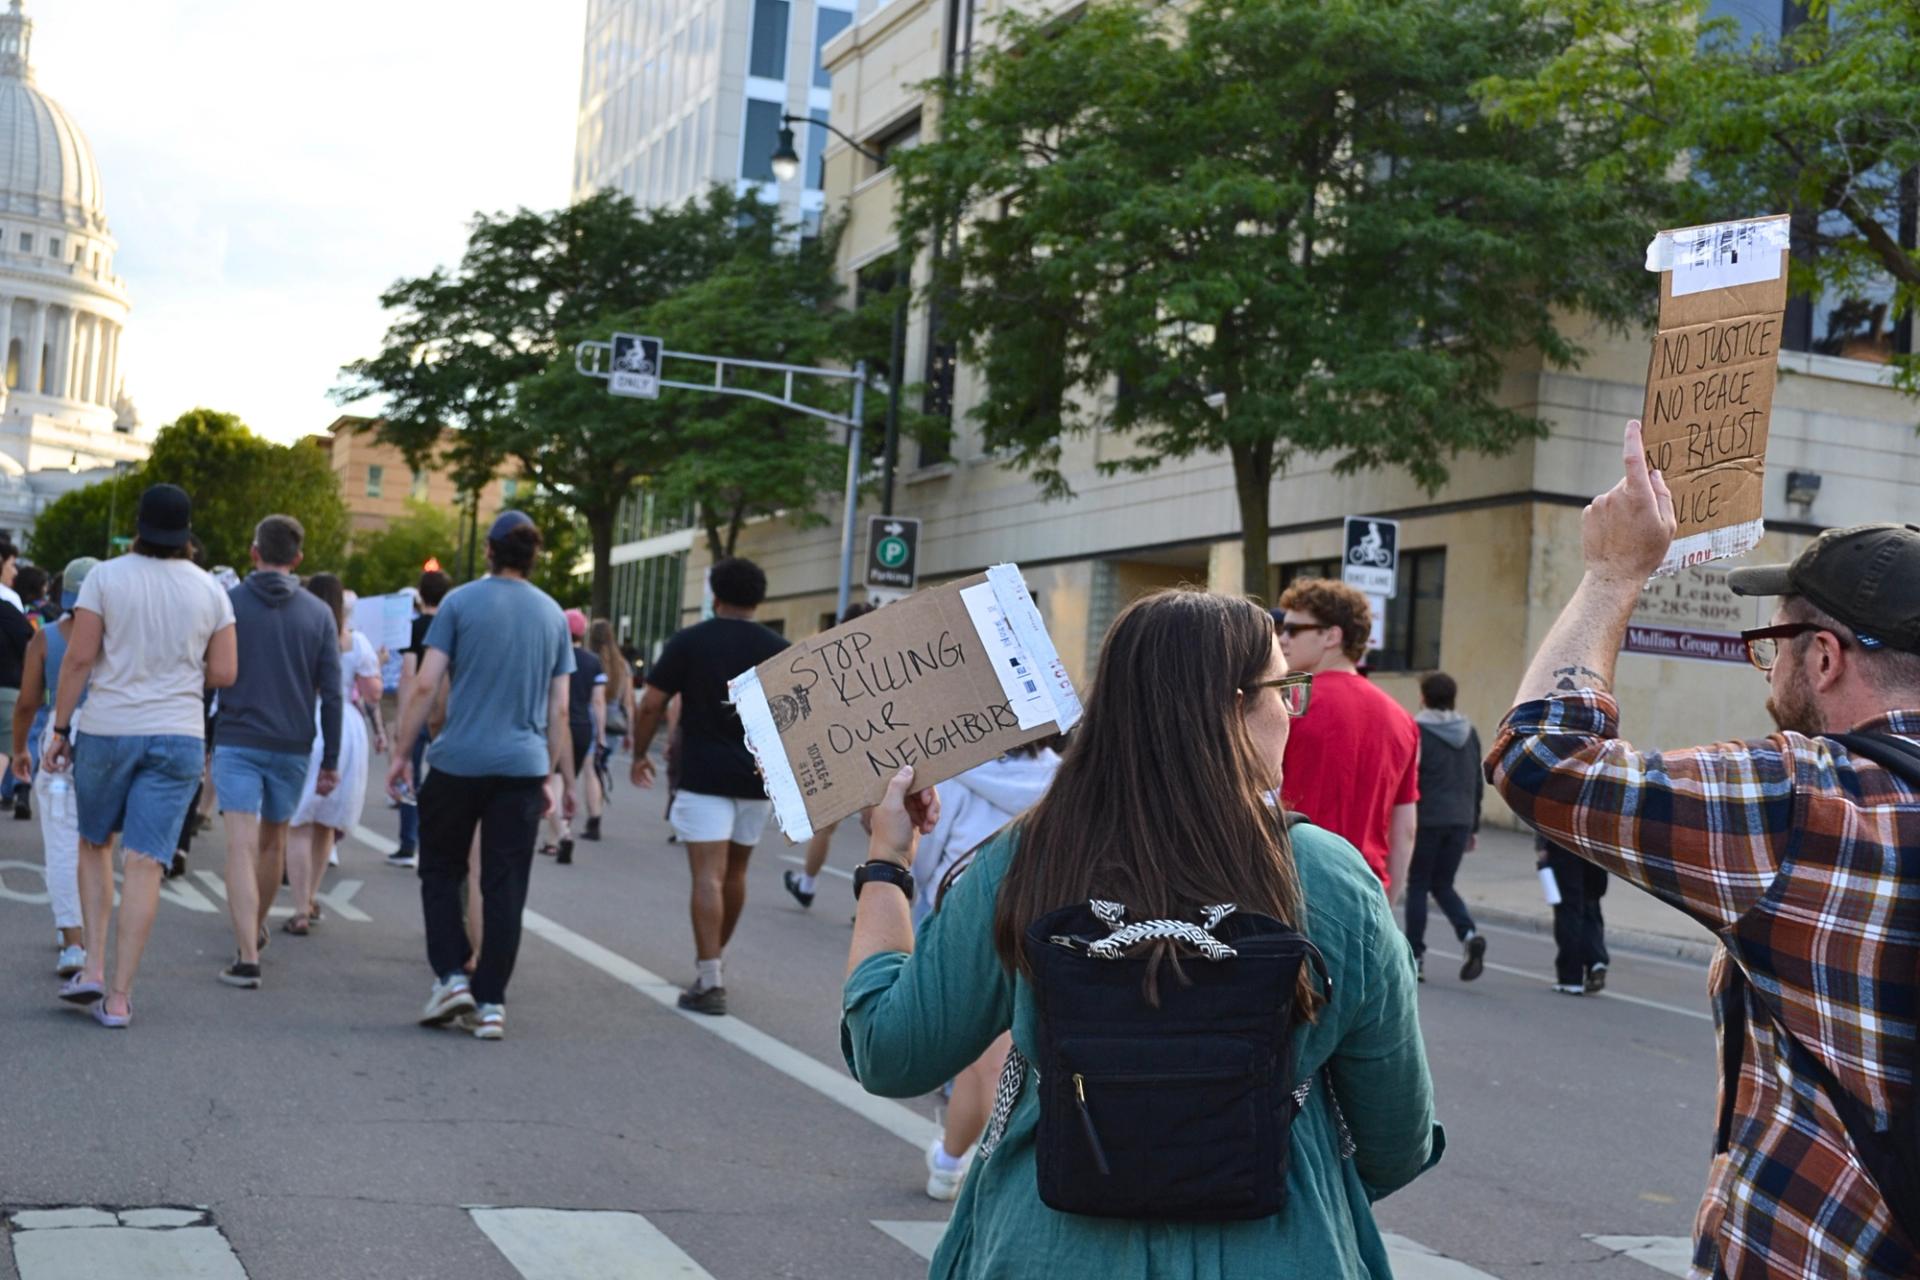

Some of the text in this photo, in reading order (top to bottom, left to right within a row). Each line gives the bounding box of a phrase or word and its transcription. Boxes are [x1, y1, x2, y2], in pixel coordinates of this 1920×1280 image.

[1661, 319, 1776, 379] NO JUSTICE
[1653, 371, 1755, 425] NO PEACE
[1646, 407, 1763, 471] NO RACIST
[1673, 483, 1721, 524] LICE
[886, 542, 902, 562] P
[870, 569, 910, 584] Parking
[1368, 574, 1389, 586] LANE
[1675, 582, 1732, 603] Lease
[1689, 567, 1727, 586] Spa
[1633, 598, 1741, 620] 8-285-8095
[1628, 628, 1677, 649] Mullins
[1723, 642, 1746, 657] LLC
[790, 631, 872, 690] STOP
[830, 630, 966, 707] KILLING
[827, 701, 909, 754] OUR
